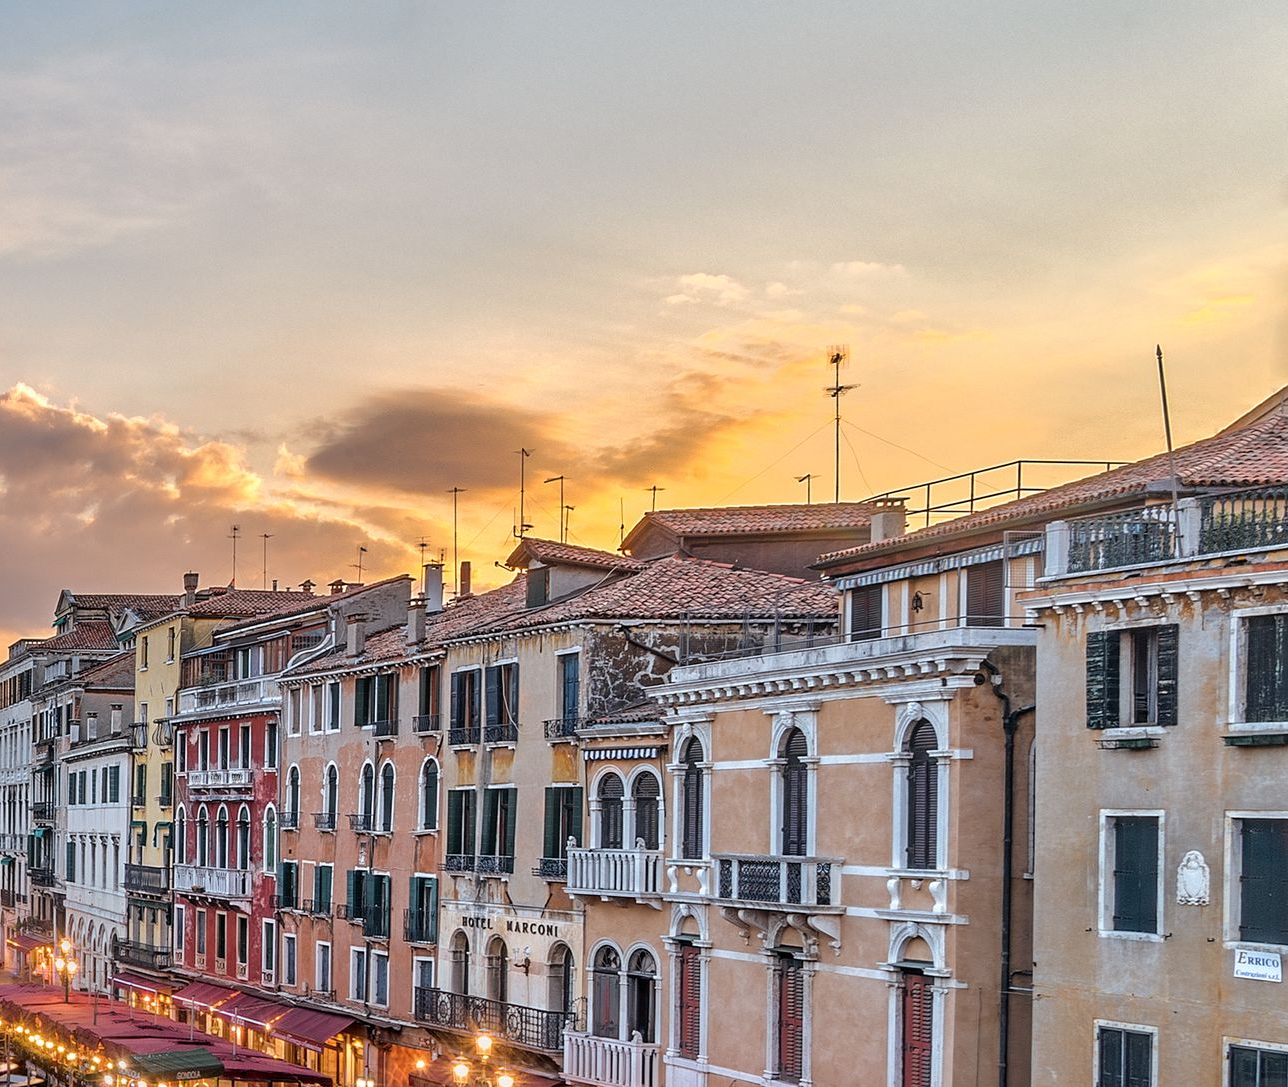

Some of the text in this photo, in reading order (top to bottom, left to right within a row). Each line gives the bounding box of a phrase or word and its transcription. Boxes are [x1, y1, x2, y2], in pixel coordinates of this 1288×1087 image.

[462, 916, 559, 938] HOTEL MARCONI
[1238, 951, 1279, 968] ERRICO
